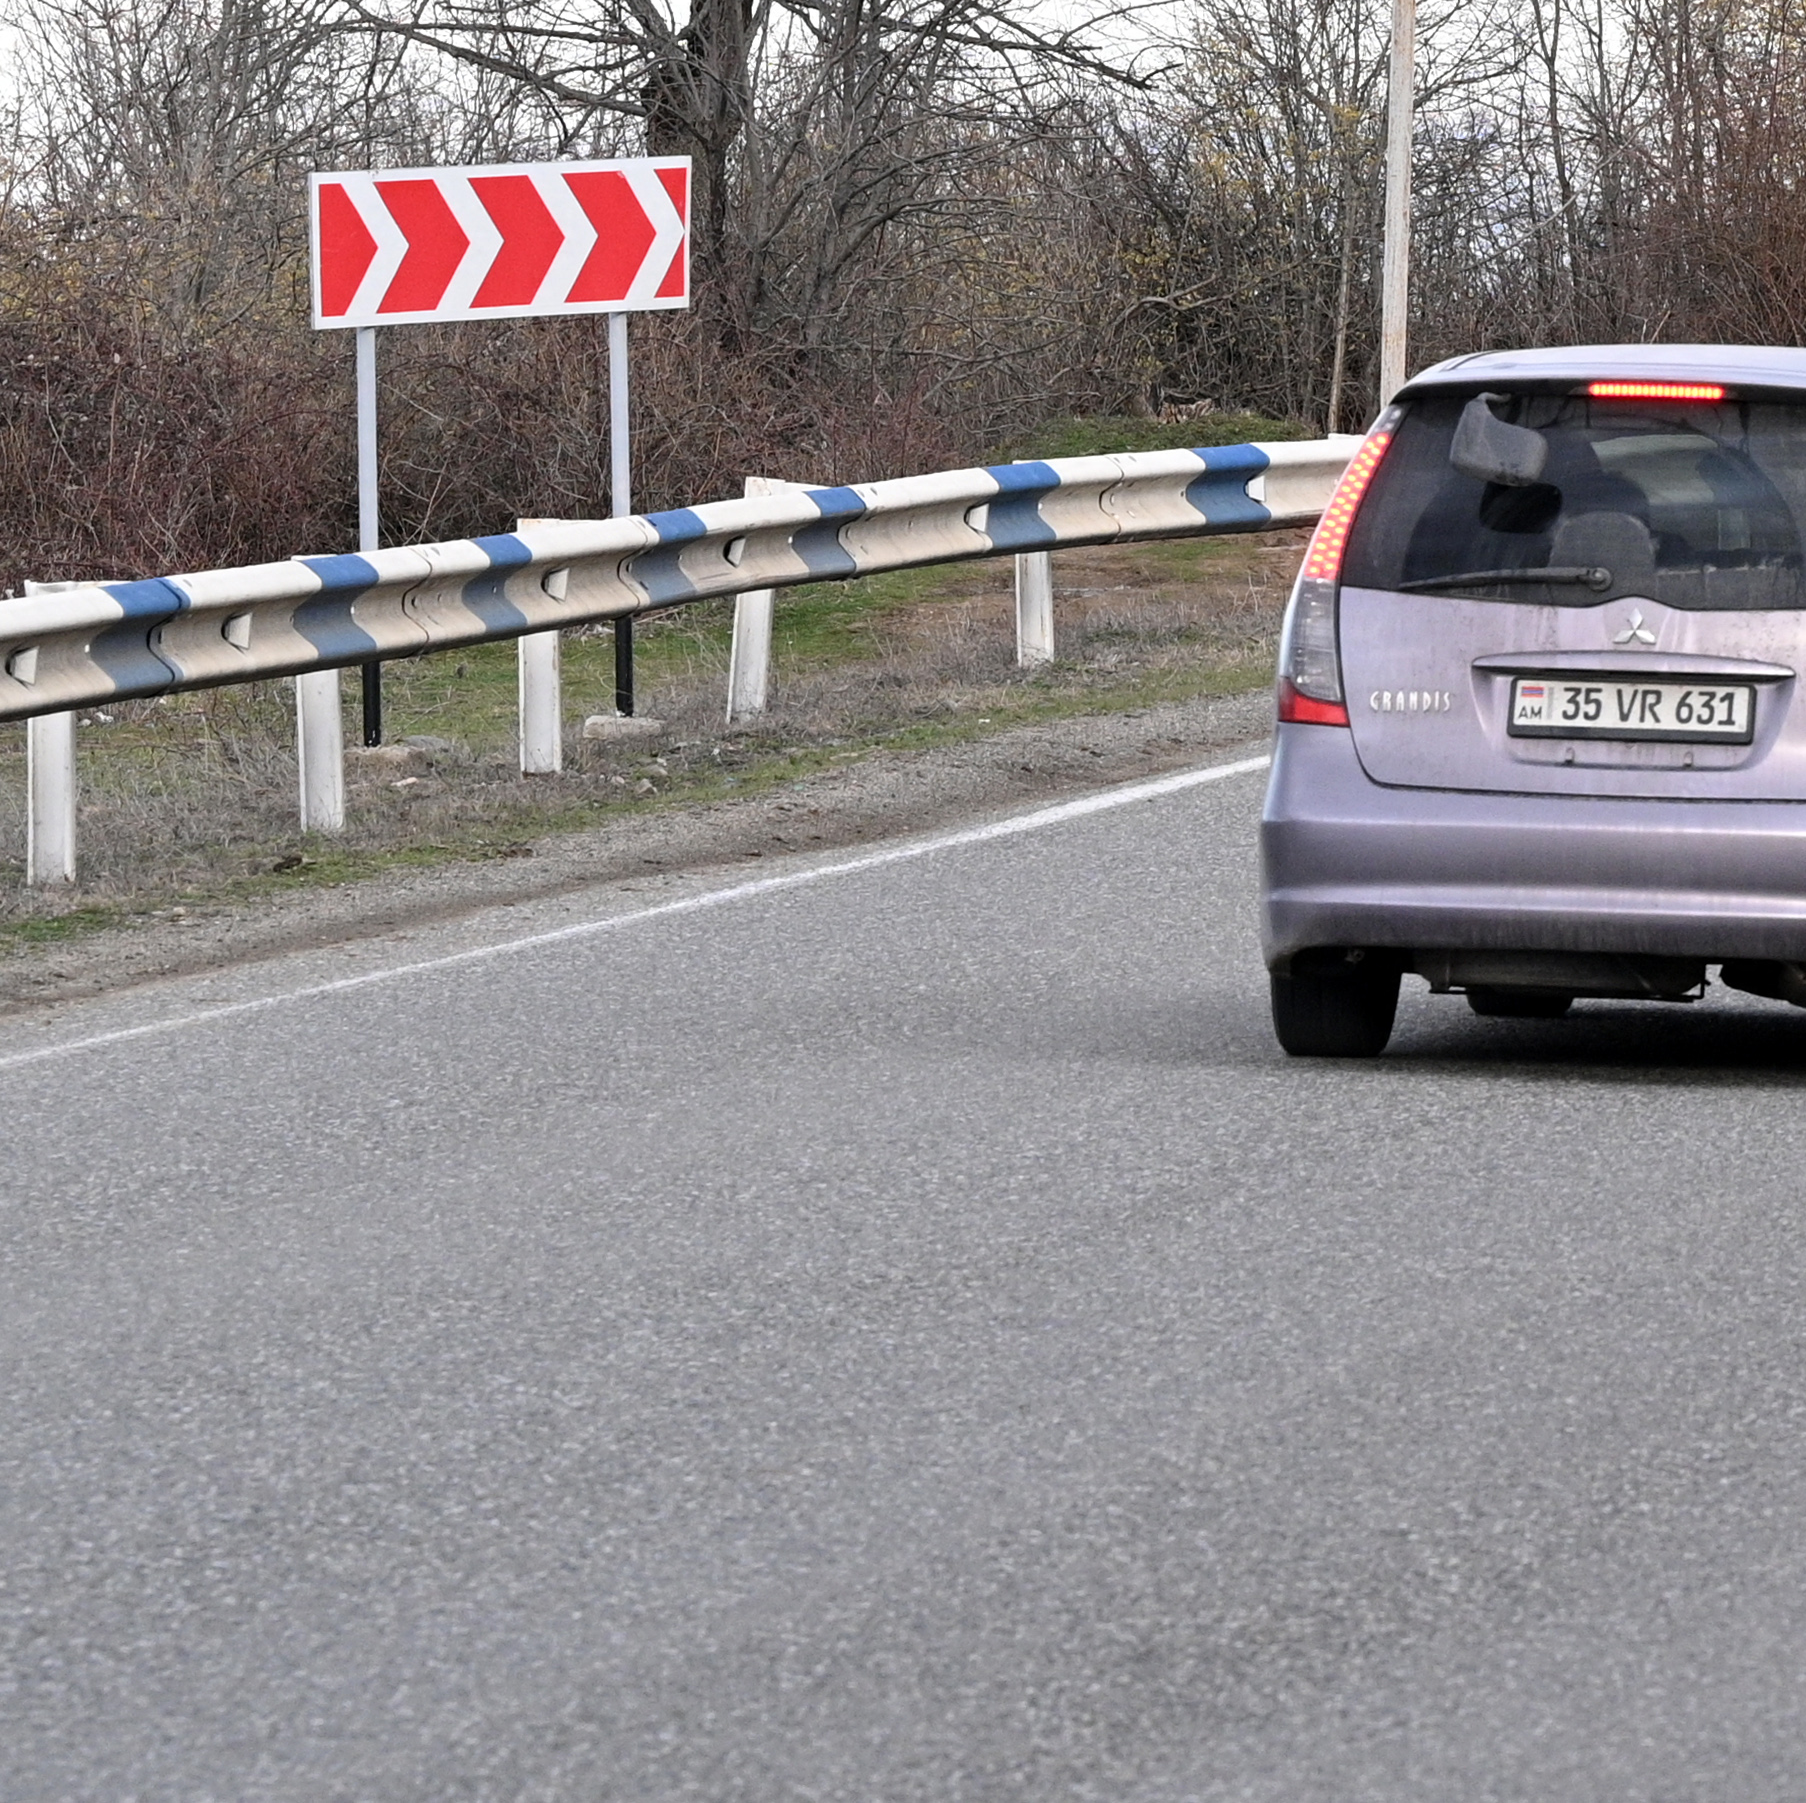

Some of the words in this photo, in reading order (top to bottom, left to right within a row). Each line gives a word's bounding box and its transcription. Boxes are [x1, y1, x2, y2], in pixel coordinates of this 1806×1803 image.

[1369, 690, 1451, 712] GRANDIS
[1561, 686, 1603, 722] 35
[1616, 688, 1663, 724] VR
[1675, 690, 1736, 727] 631
[1518, 705, 1542, 720] AM
